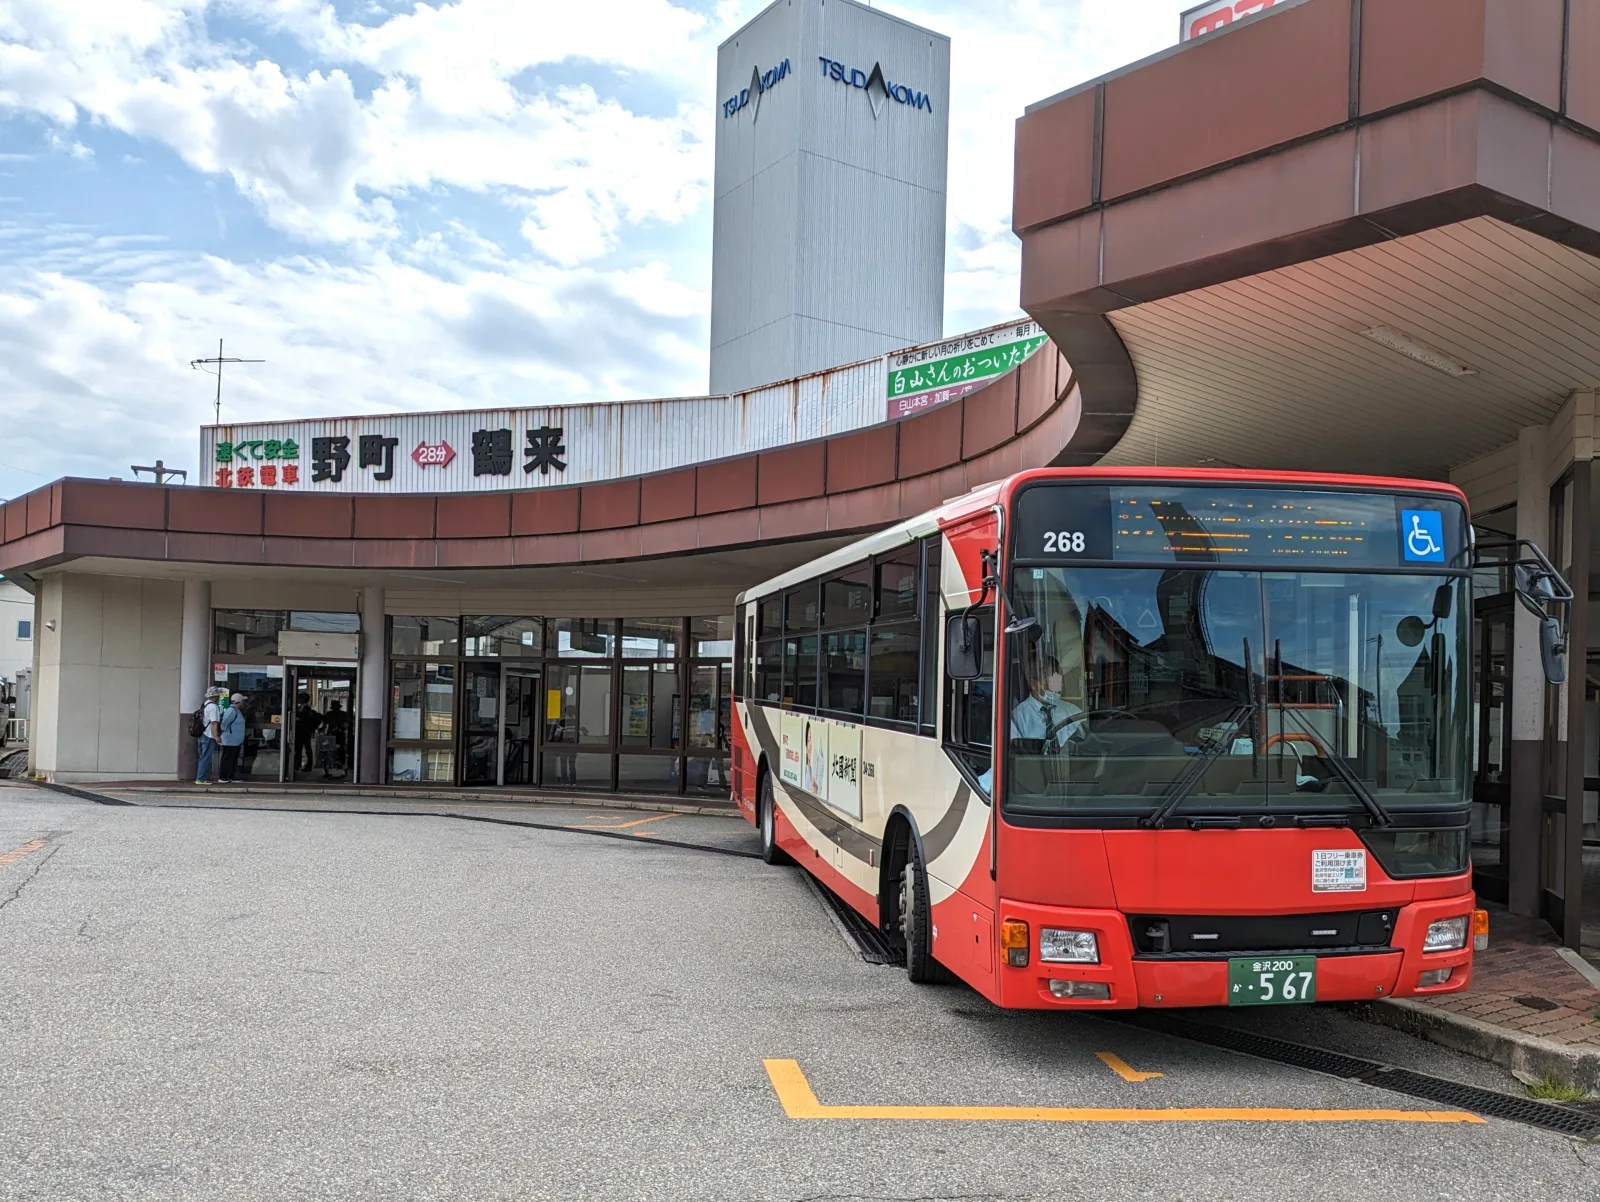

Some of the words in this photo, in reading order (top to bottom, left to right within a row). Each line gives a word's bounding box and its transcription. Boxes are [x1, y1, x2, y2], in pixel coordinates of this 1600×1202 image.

[215, 438, 300, 463] 速くて安全
[311, 434, 399, 483] 野町
[418, 445, 448, 464] 28分
[471, 425, 568, 477] 鶴来
[215, 463, 299, 488] 北鉄電車
[1043, 531, 1086, 553] 268
